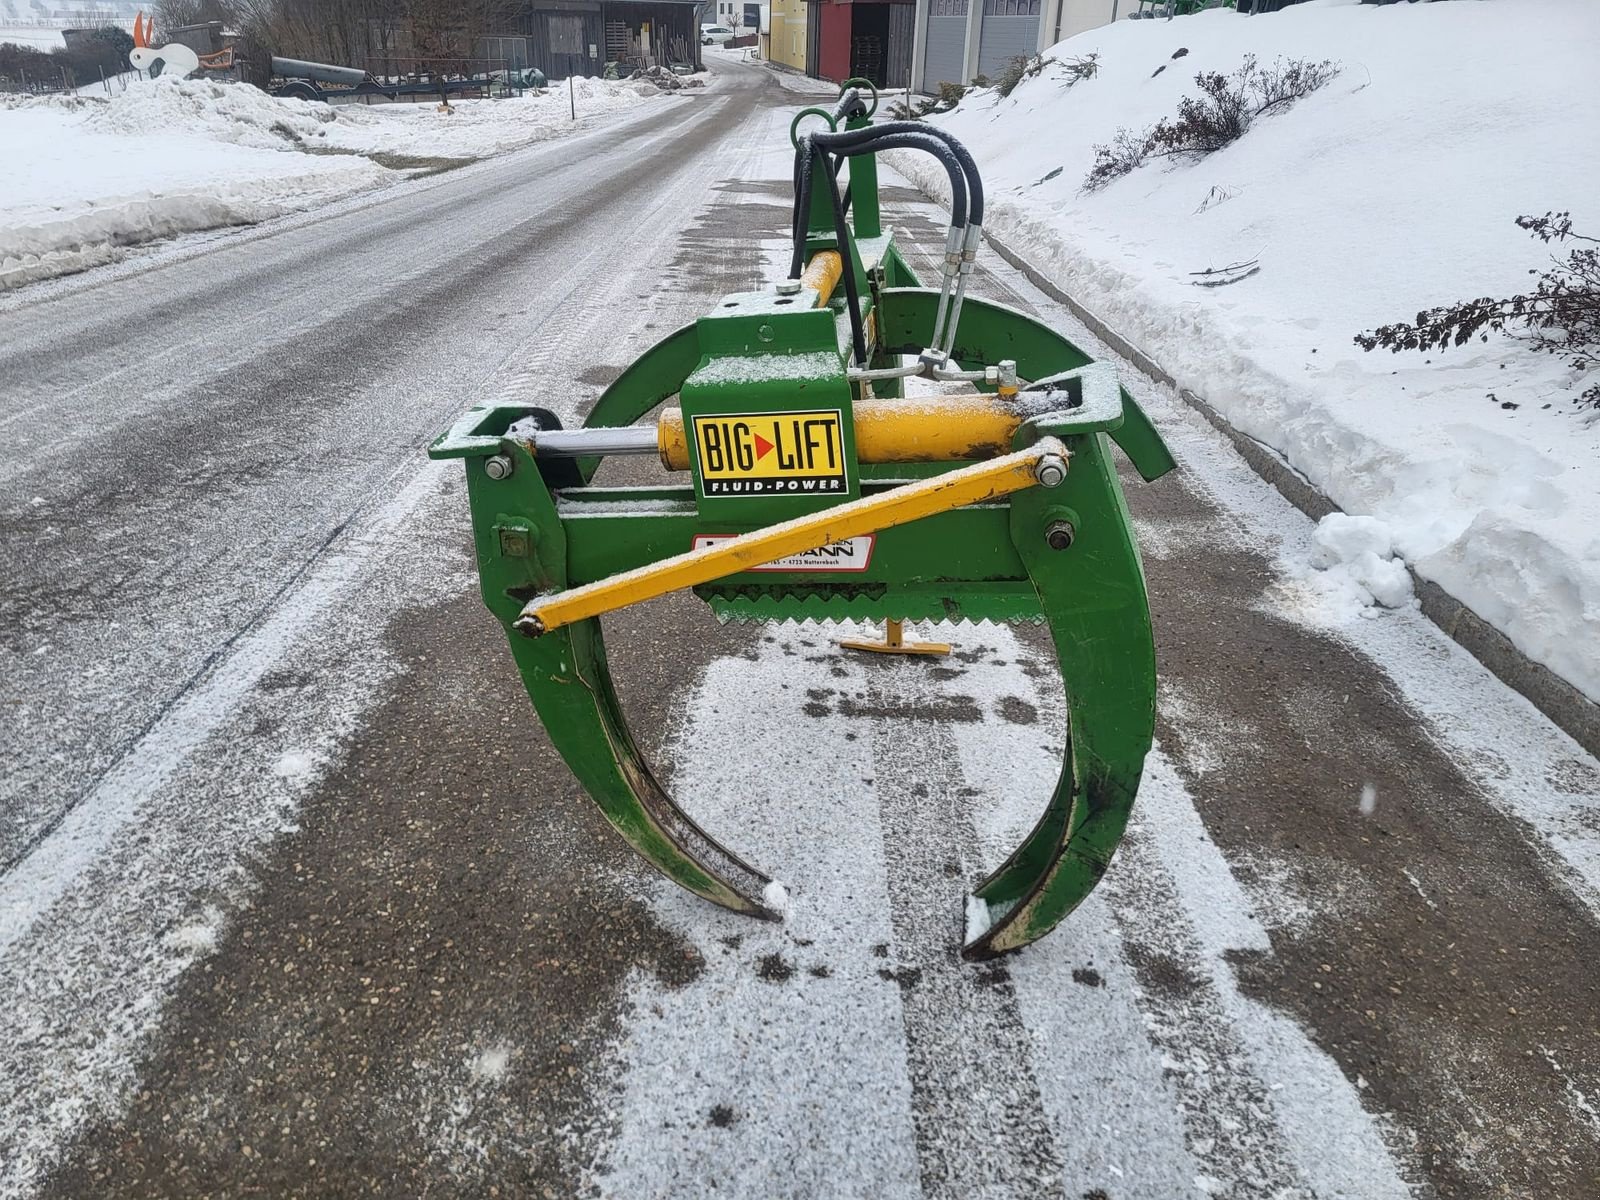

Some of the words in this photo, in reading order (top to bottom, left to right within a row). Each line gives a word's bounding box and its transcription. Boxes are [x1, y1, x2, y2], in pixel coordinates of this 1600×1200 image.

[703, 422, 754, 472] BIG
[774, 419, 836, 470] LIFT
[712, 479, 840, 492] FLUID-POWER
